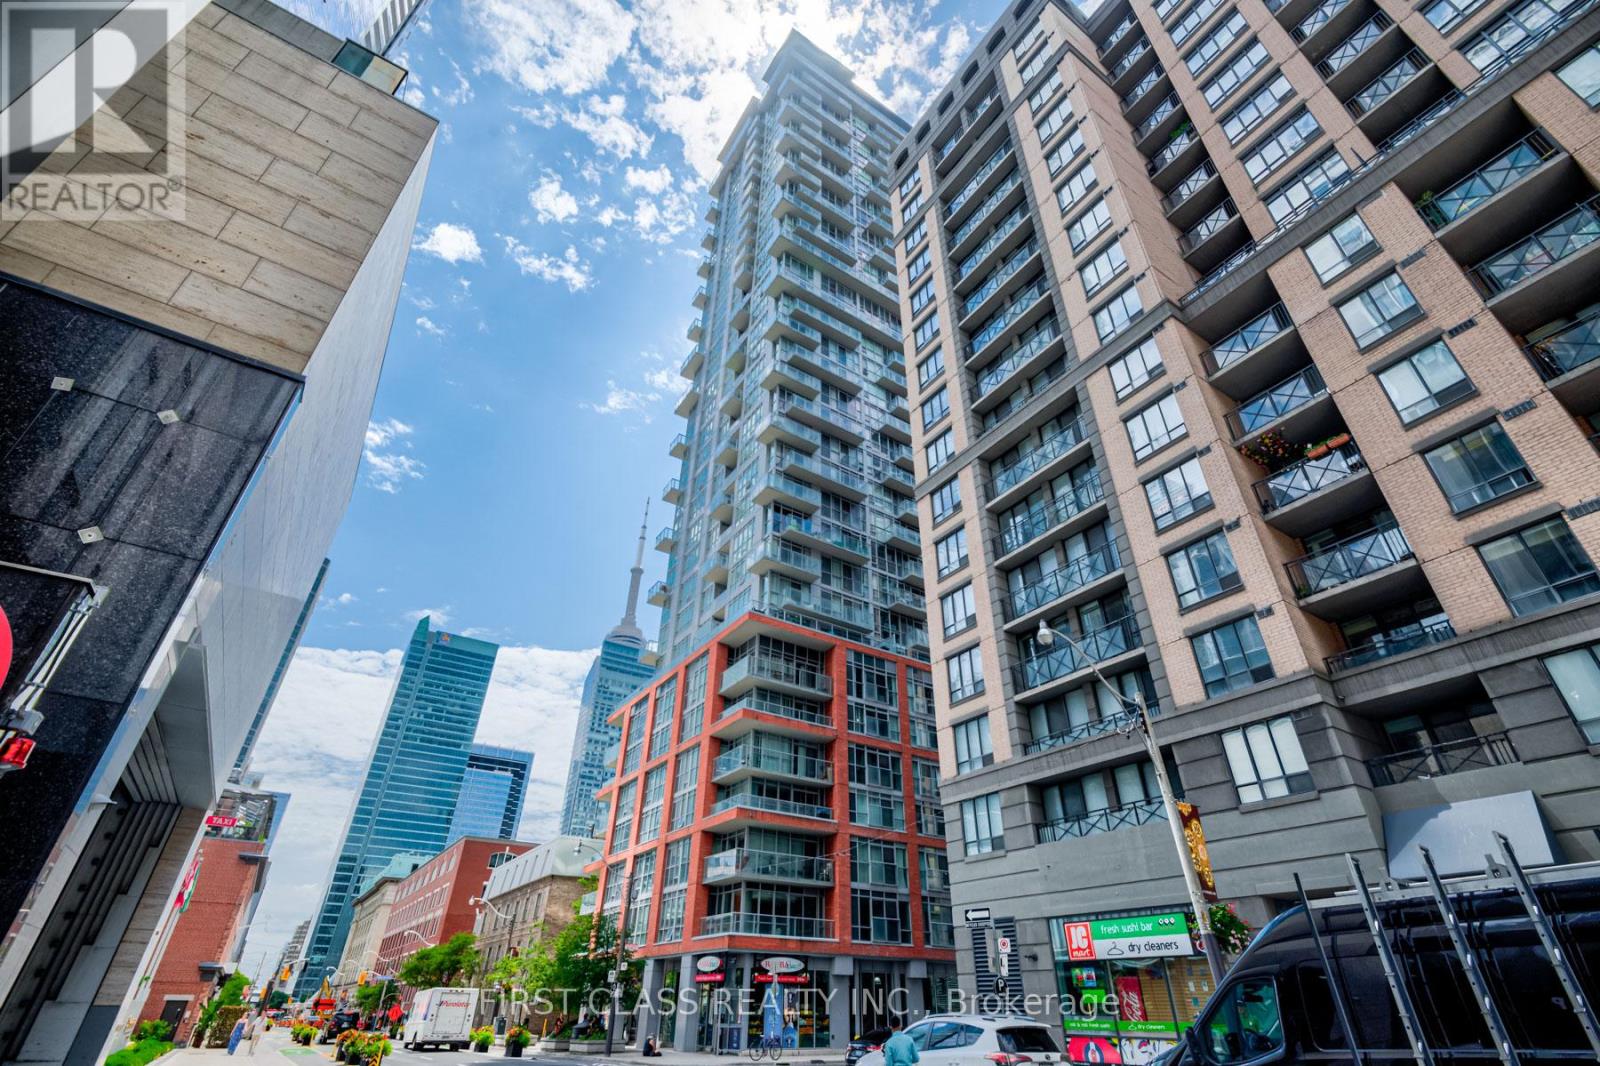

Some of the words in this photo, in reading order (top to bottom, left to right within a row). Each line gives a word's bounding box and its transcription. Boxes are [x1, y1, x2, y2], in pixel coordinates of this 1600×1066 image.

[213, 817, 233, 825] TAXI
[1101, 924, 1119, 934] fresh
[1121, 922, 1139, 933] sushi
[1140, 922, 1153, 931] bar
[1070, 926, 1088, 950] JC
[1073, 949, 1090, 957] mart
[1128, 941, 1141, 954] dry
[1144, 940, 1179, 951] cleaners
[998, 979, 1005, 991] P
